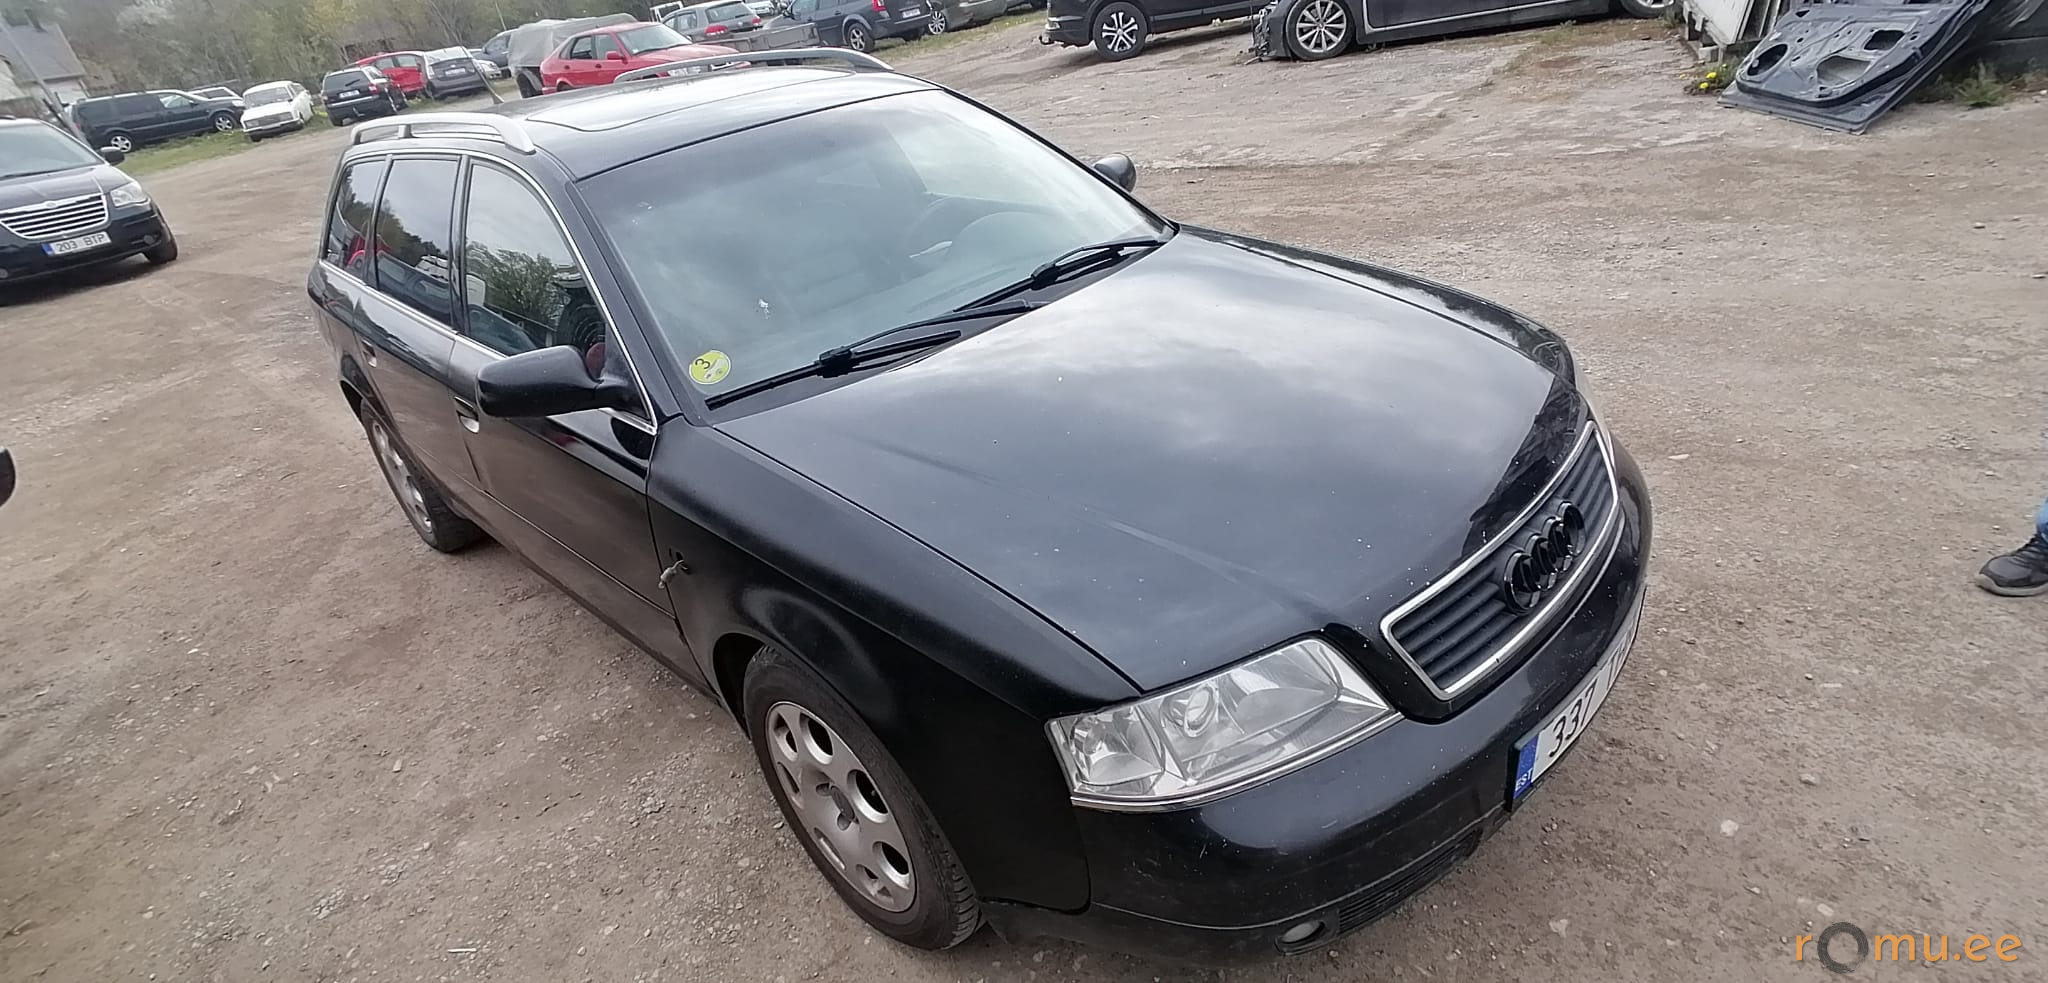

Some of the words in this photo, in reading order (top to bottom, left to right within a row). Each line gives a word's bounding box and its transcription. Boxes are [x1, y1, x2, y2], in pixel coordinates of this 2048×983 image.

[55, 240, 78, 252] 203
[83, 233, 105, 246] BTP
[694, 358, 711, 370] 3
[1549, 678, 1598, 757] 337
[1514, 768, 1533, 791] EST
